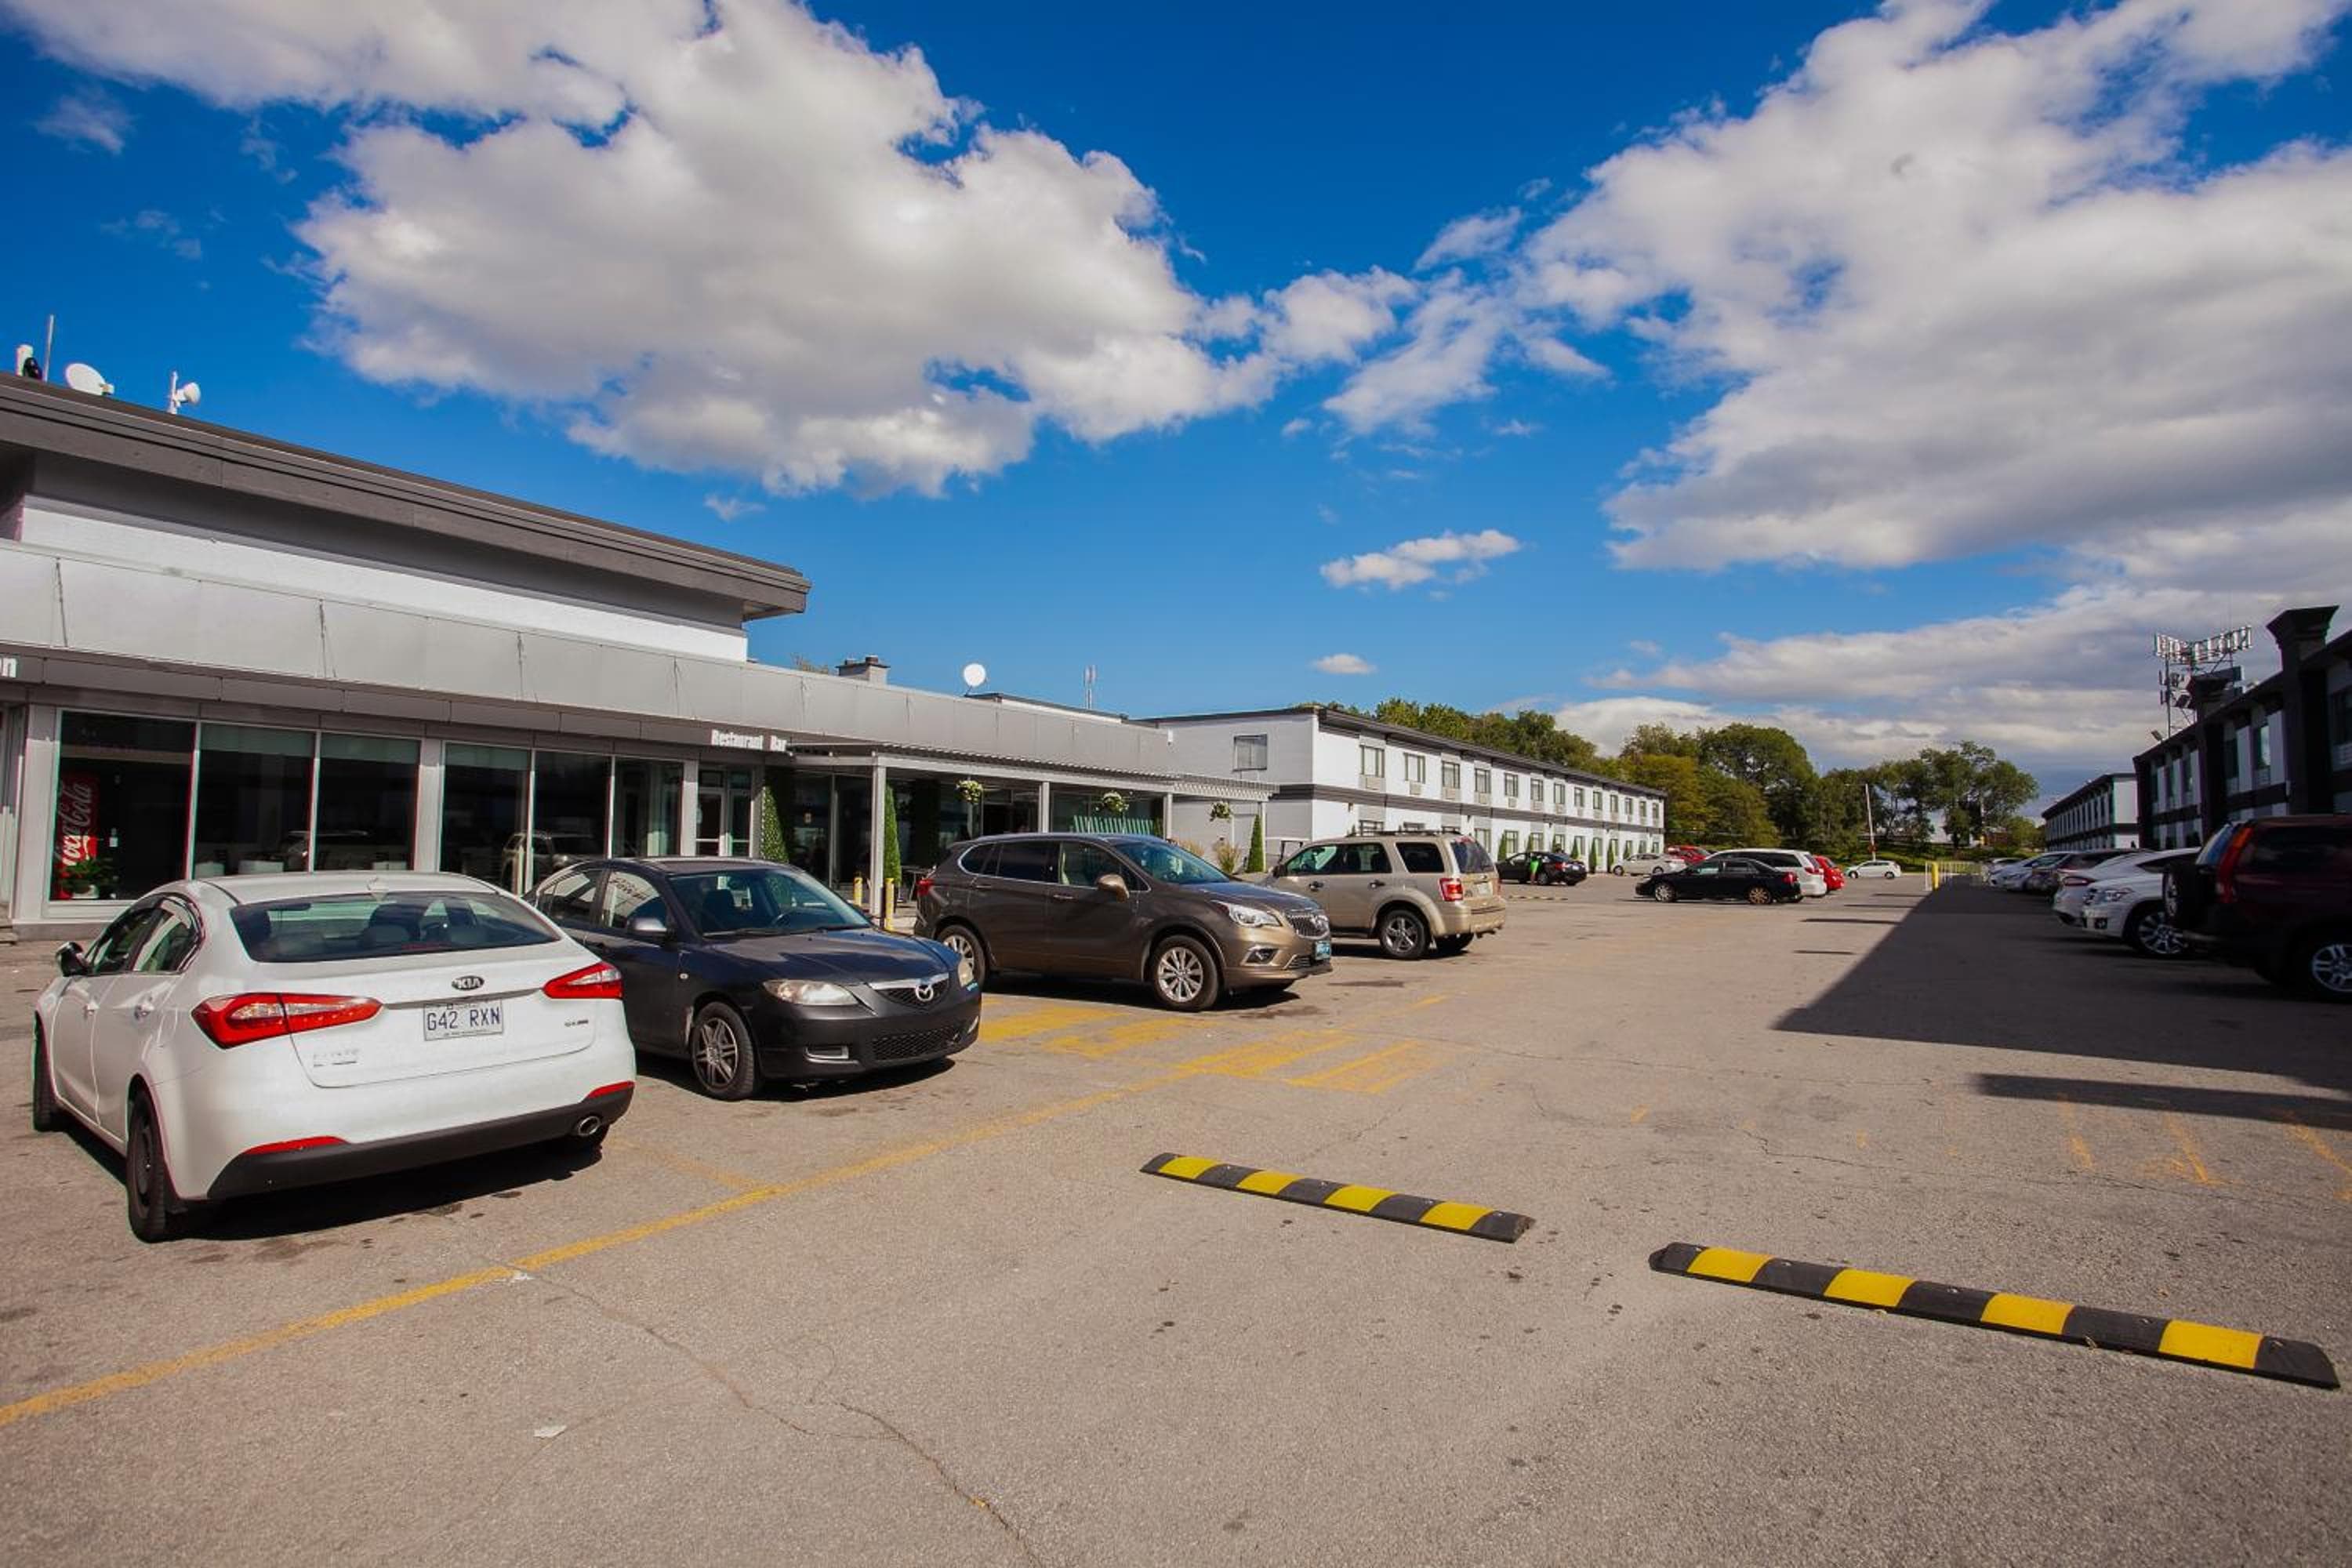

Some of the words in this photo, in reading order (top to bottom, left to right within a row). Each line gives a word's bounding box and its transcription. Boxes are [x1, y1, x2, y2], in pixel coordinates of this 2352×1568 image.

[711, 729, 763, 750] Restaurant
[770, 735, 787, 752] Bar
[454, 978, 482, 989] KIA
[426, 1011, 458, 1031] G42
[470, 1007, 500, 1027] RXN
